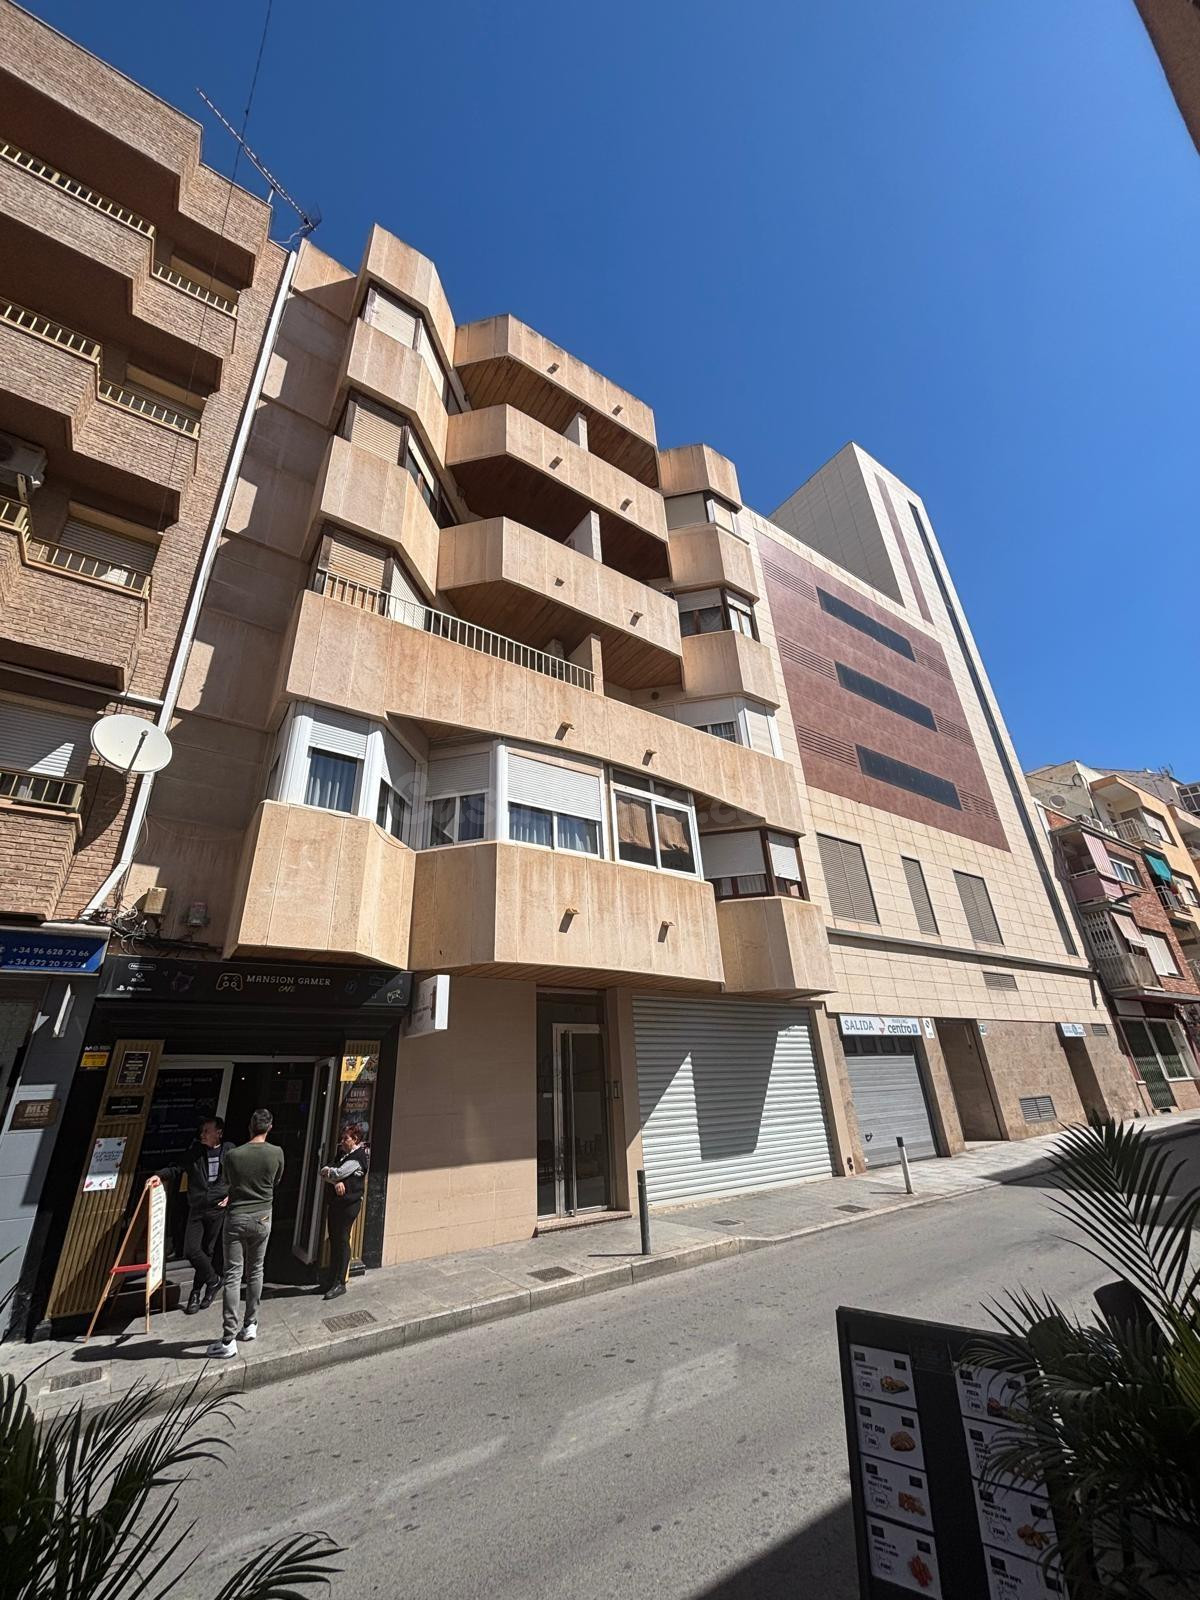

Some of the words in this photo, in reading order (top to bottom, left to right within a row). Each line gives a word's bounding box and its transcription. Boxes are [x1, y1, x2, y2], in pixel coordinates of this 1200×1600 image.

[12, 946, 31, 954] +34
[8, 958, 27, 966] +34
[246, 975, 294, 984] MANSION
[297, 977, 331, 986] GAMER
[844, 1020, 875, 1031] SALIDA
[887, 1023, 912, 1033] centro
[25, 1103, 50, 1113] MLS
